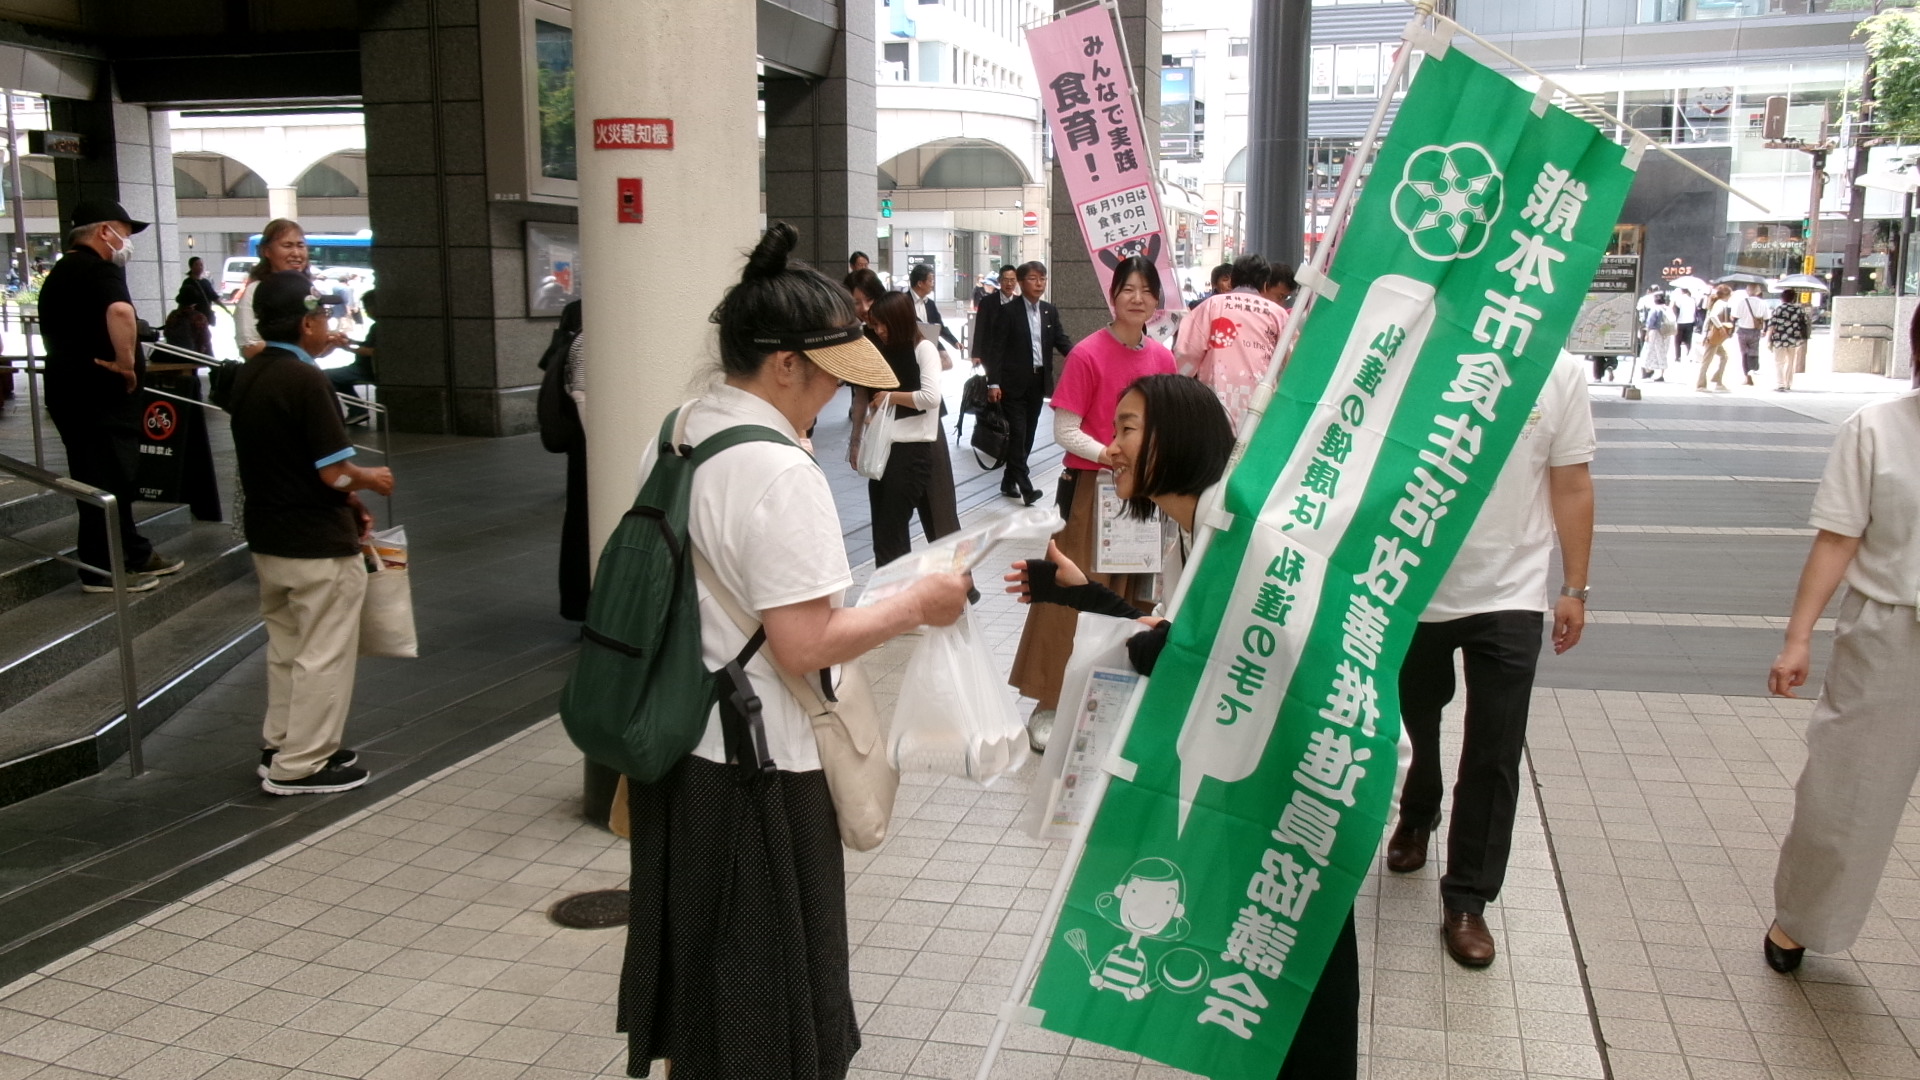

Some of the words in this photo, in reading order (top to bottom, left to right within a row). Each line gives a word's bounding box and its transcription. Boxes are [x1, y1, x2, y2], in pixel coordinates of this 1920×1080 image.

[1083, 35, 1138, 174] みんなで実践
[596, 123, 669, 145] 火災報知機
[1049, 71, 1100, 183] 食育！
[1086, 188, 1148, 217] 毎月19日は
[1098, 205, 1146, 230] 食育の日
[1103, 220, 1149, 244] だモン！
[1242, 339, 1251, 348] to
[1253, 340, 1266, 351] the
